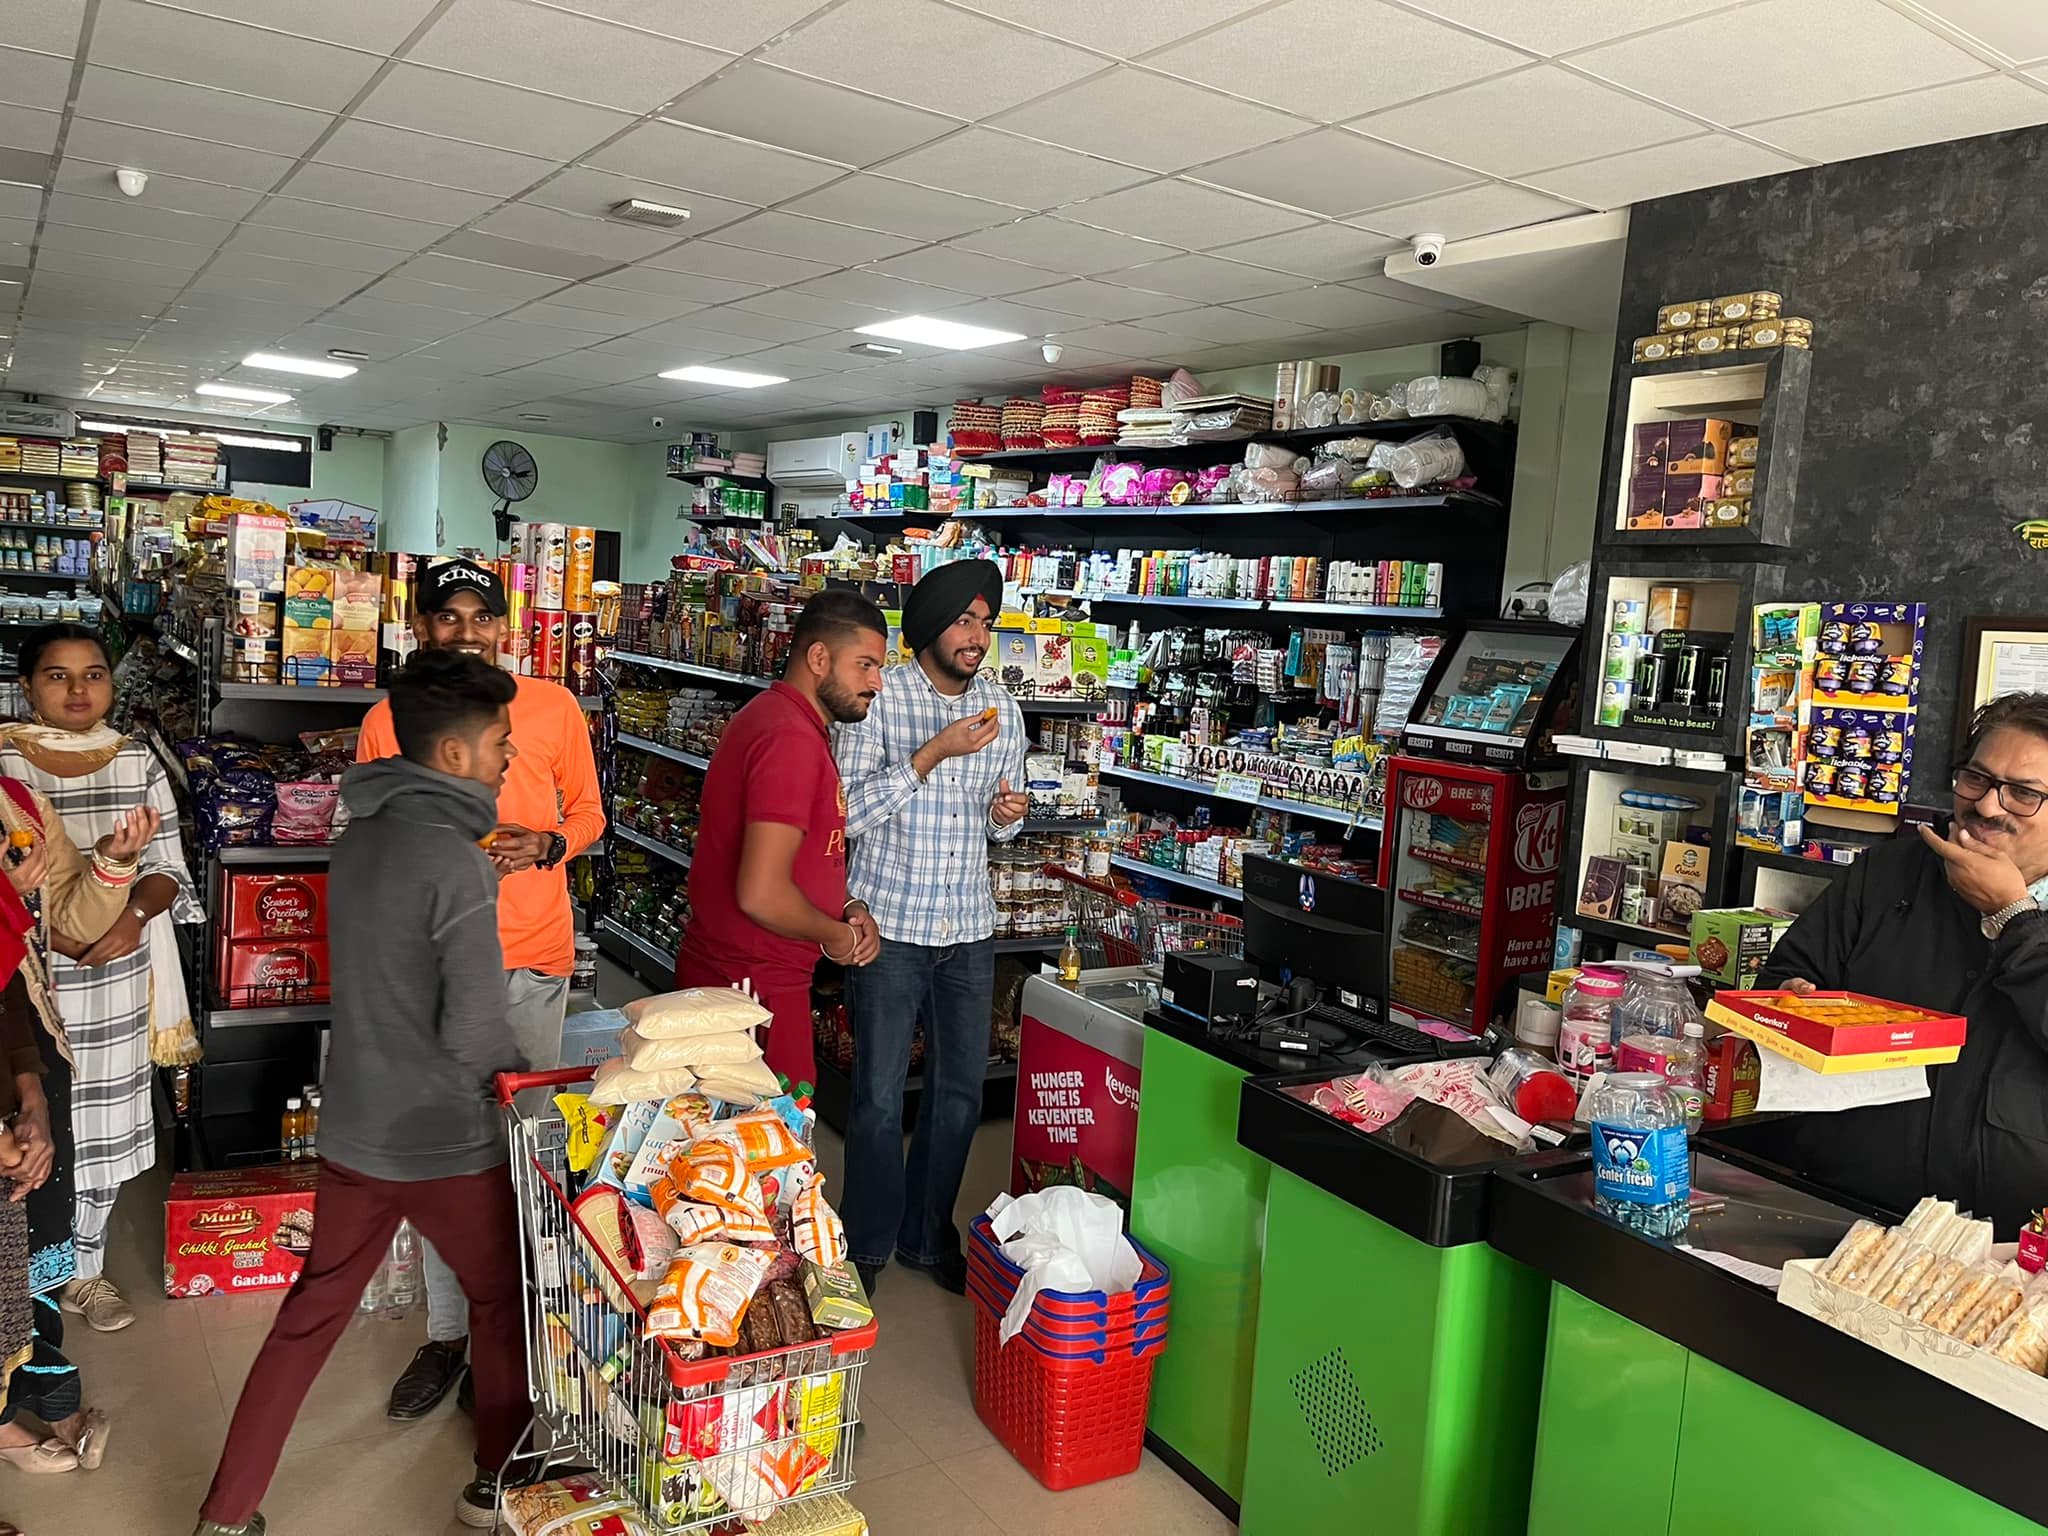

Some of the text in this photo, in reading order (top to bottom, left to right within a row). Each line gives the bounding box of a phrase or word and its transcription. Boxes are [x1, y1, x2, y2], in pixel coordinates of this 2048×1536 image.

[437, 568, 491, 588] KING
[1633, 715, 1667, 726] Unleash
[1669, 718, 1684, 727] the
[1446, 742, 1473, 754] HERSHEY'S
[1486, 747, 1514, 760] HERSHEY'S
[1674, 864, 1701, 878] Quinoa
[262, 896, 299, 909] Season's
[266, 906, 310, 920] Greetings
[1507, 940, 1533, 952] Have
[1535, 941, 1541, 949] a
[1503, 955, 1529, 968] have
[1531, 956, 1537, 965] a
[262, 965, 299, 977] Season's
[1754, 1013, 1788, 1029] Goenka's
[1031, 1071, 1084, 1089] HUNGER
[1037, 1089, 1080, 1107] TIME IS
[1028, 1108, 1095, 1125] KEVENTER
[1047, 1126, 1078, 1143] TIME
[1598, 1164, 1653, 1187] Center fresh
[200, 1209, 253, 1224] Murli
[178, 1237, 270, 1257] Chikki Gachak
[232, 1272, 285, 1287] Gachak
